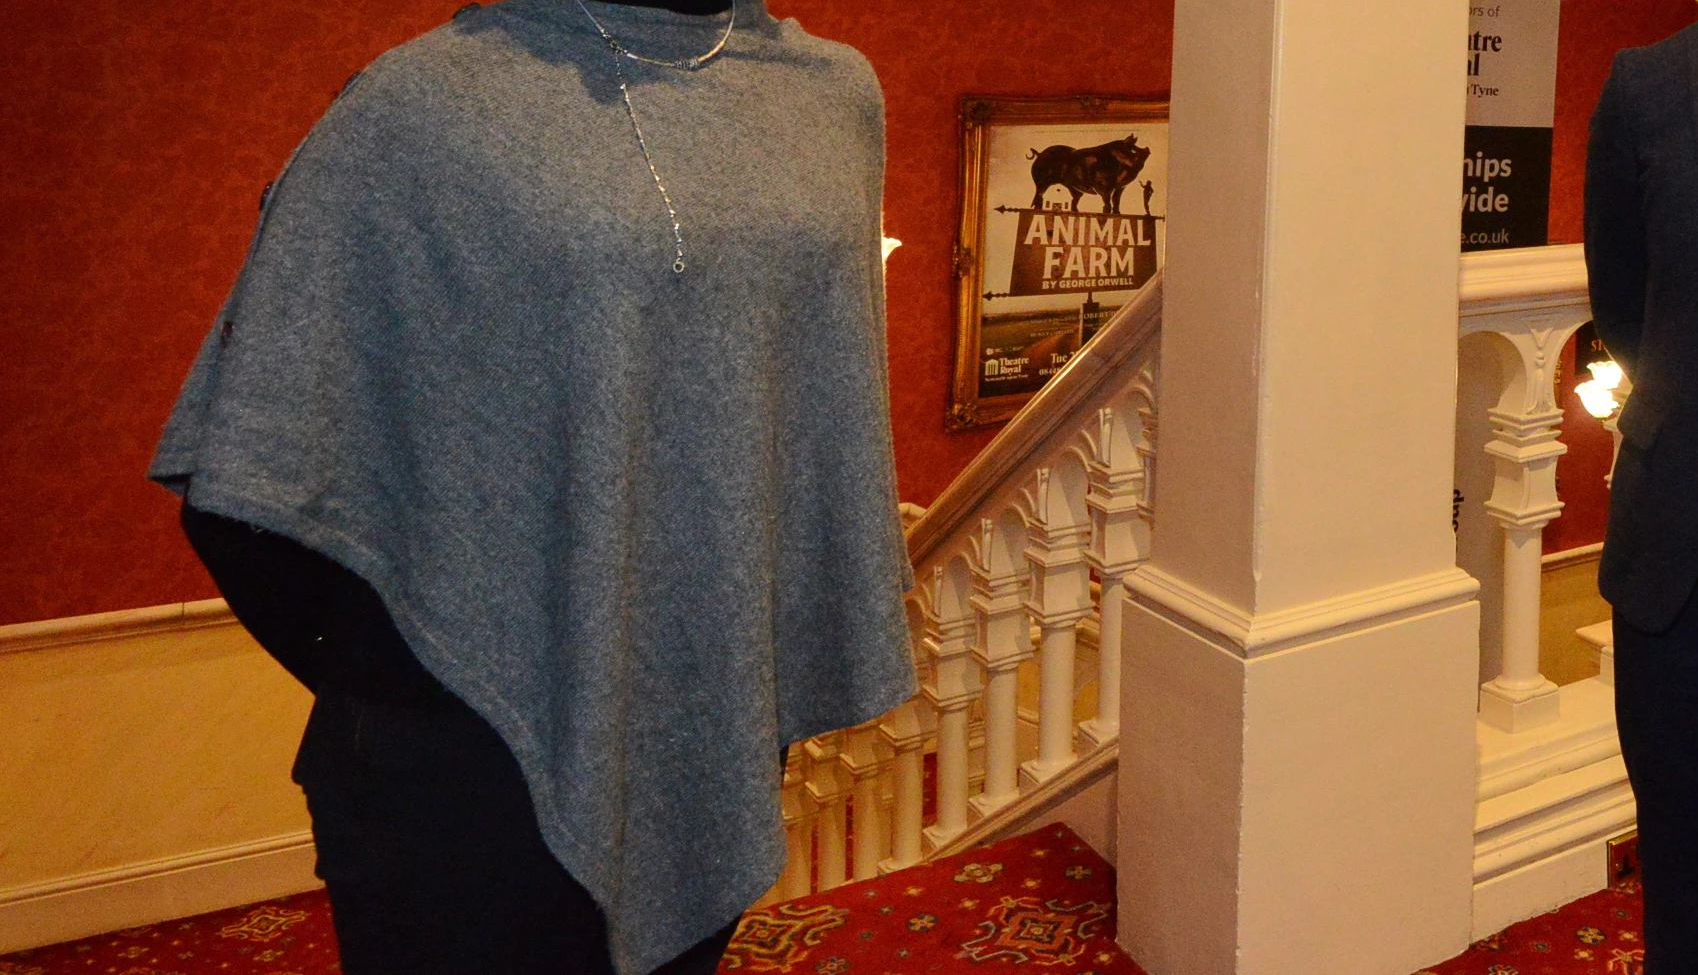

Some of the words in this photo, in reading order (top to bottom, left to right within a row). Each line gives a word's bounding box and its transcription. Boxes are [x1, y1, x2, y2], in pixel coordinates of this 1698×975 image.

[1487, 5, 1500, 17] of
[1471, 84, 1499, 98] Tyne
[1024, 214, 1151, 246] ANIMAL
[1042, 246, 1134, 279] FARM
[1042, 280, 1057, 290] BY
[1059, 279, 1097, 289] GEORGE
[1098, 277, 1134, 287] ORWELL
[999, 357, 1030, 366] Theatre
[1000, 365, 1022, 375] Royal
